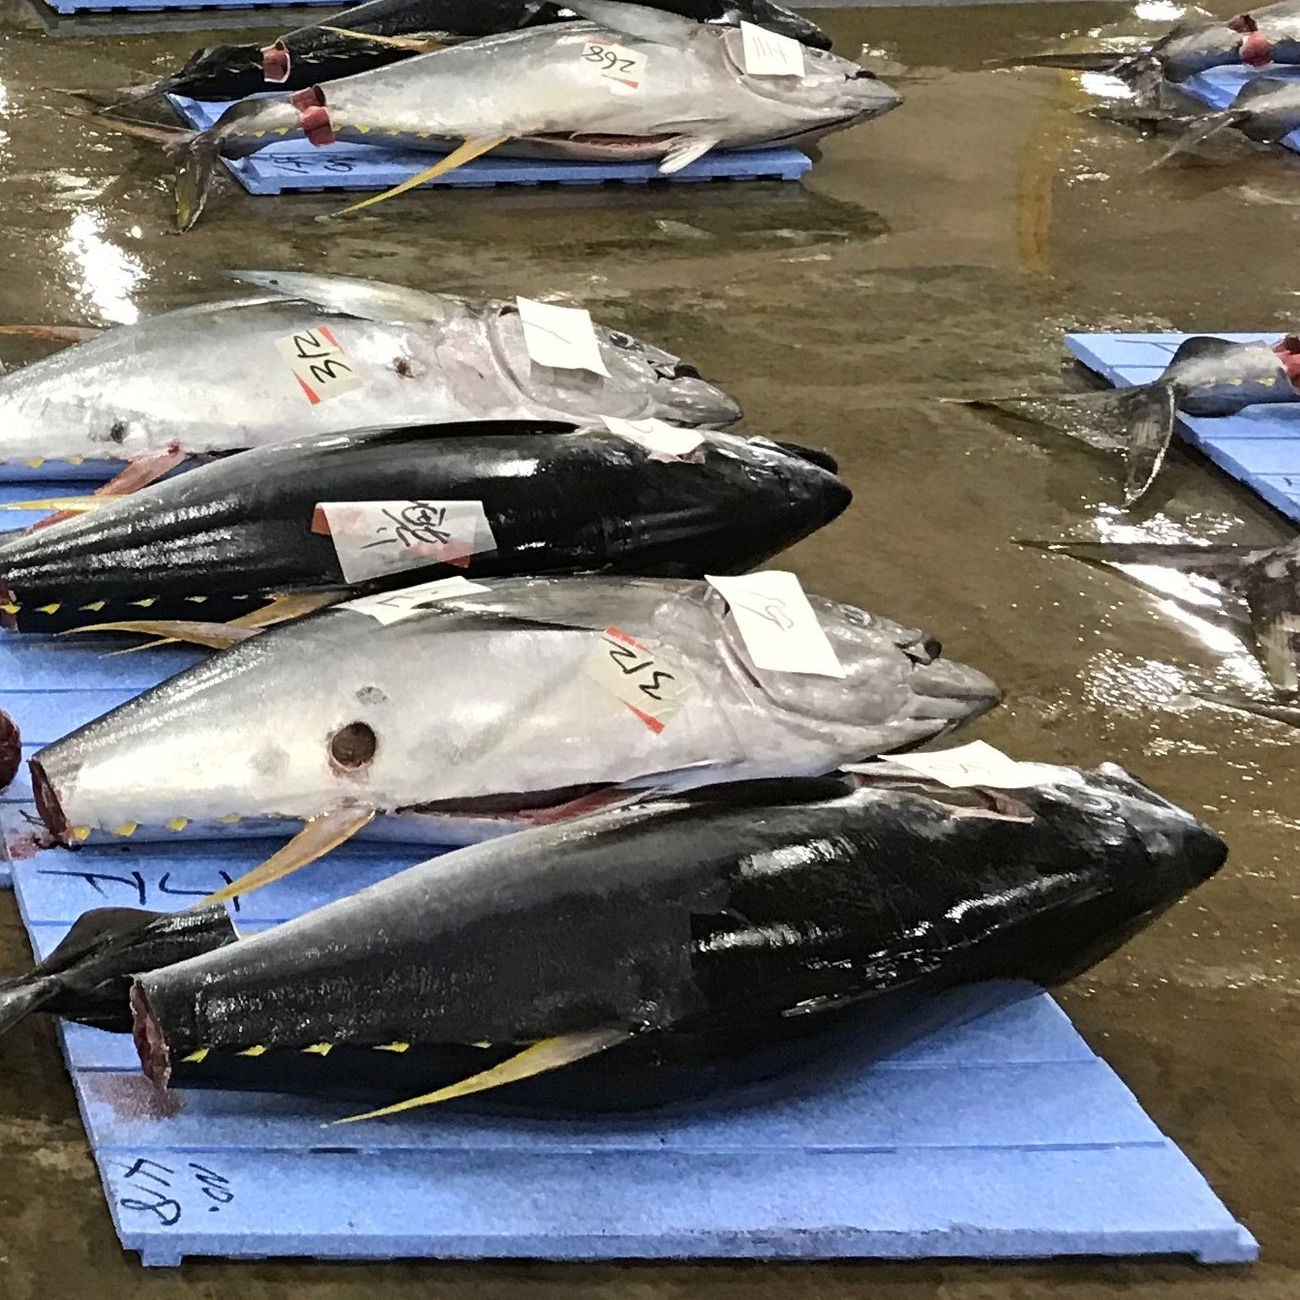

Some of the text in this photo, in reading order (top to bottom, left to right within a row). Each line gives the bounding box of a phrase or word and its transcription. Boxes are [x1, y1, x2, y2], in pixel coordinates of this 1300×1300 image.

[580, 41, 638, 74] 268
[291, 328, 347, 387] 312
[605, 640, 676, 702] 312
